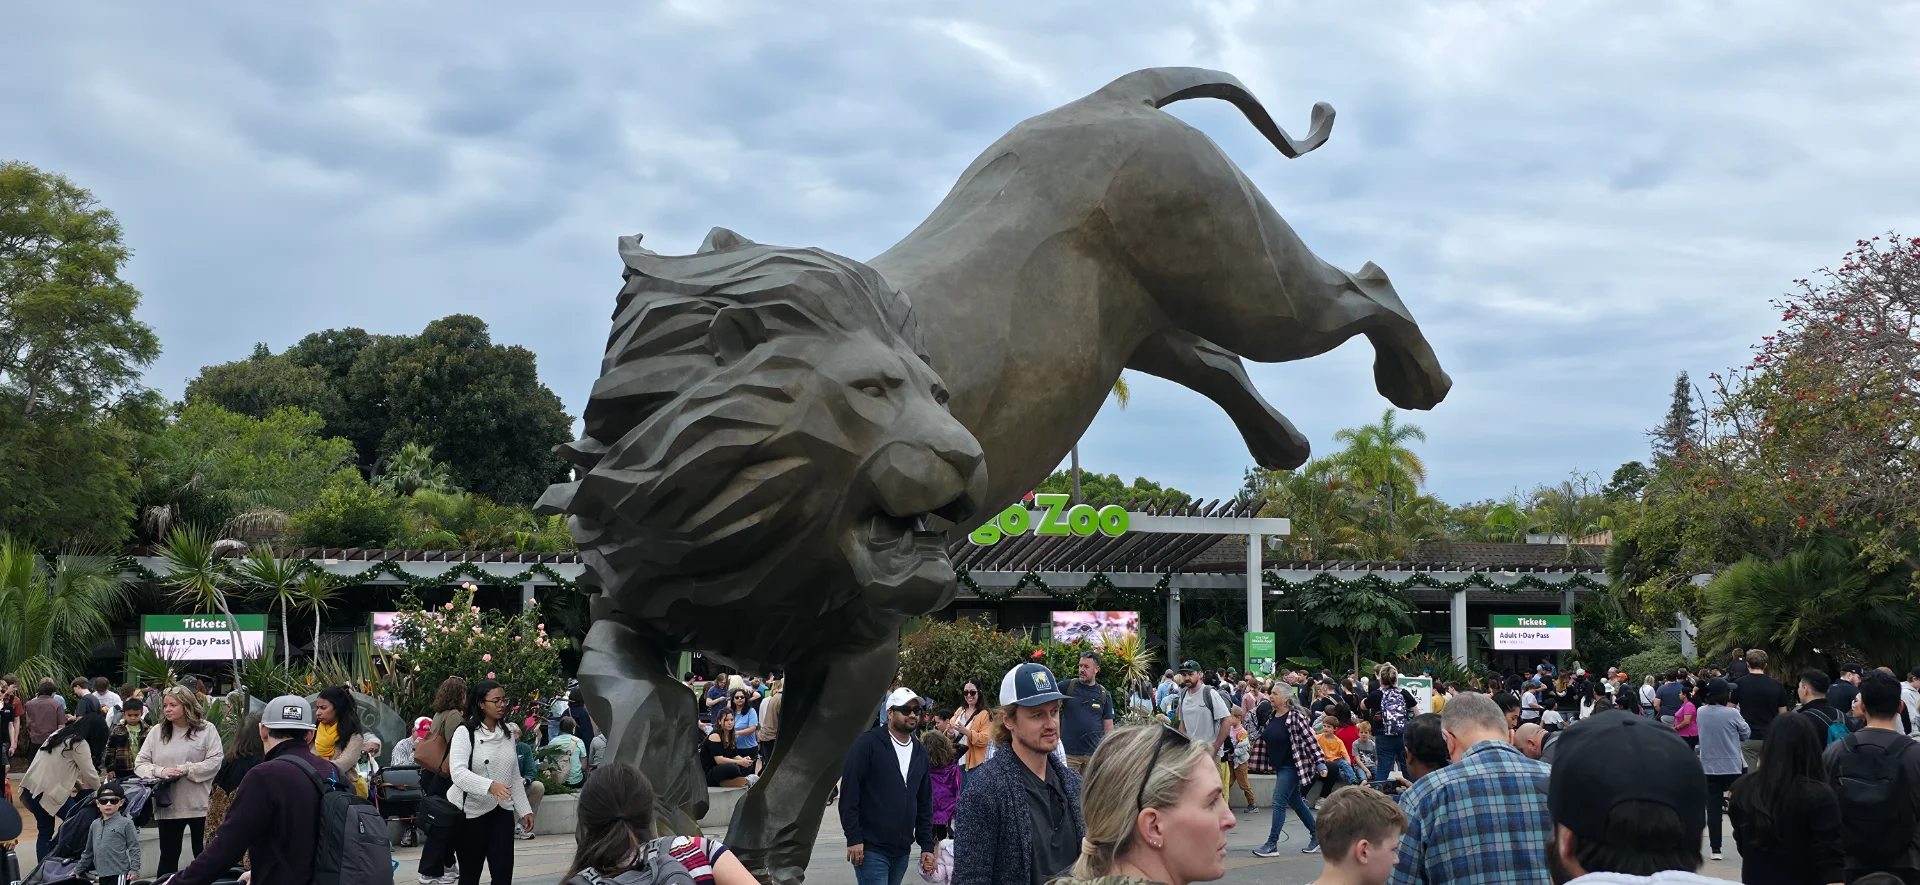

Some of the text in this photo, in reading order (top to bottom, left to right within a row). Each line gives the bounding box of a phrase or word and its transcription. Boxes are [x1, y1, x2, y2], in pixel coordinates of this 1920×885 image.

[1034, 493, 1130, 537] Zoo
[183, 618, 227, 628] Tickets
[1518, 617, 1547, 626] Tickets
[153, 637, 231, 647] Adult 1-Day Pass
